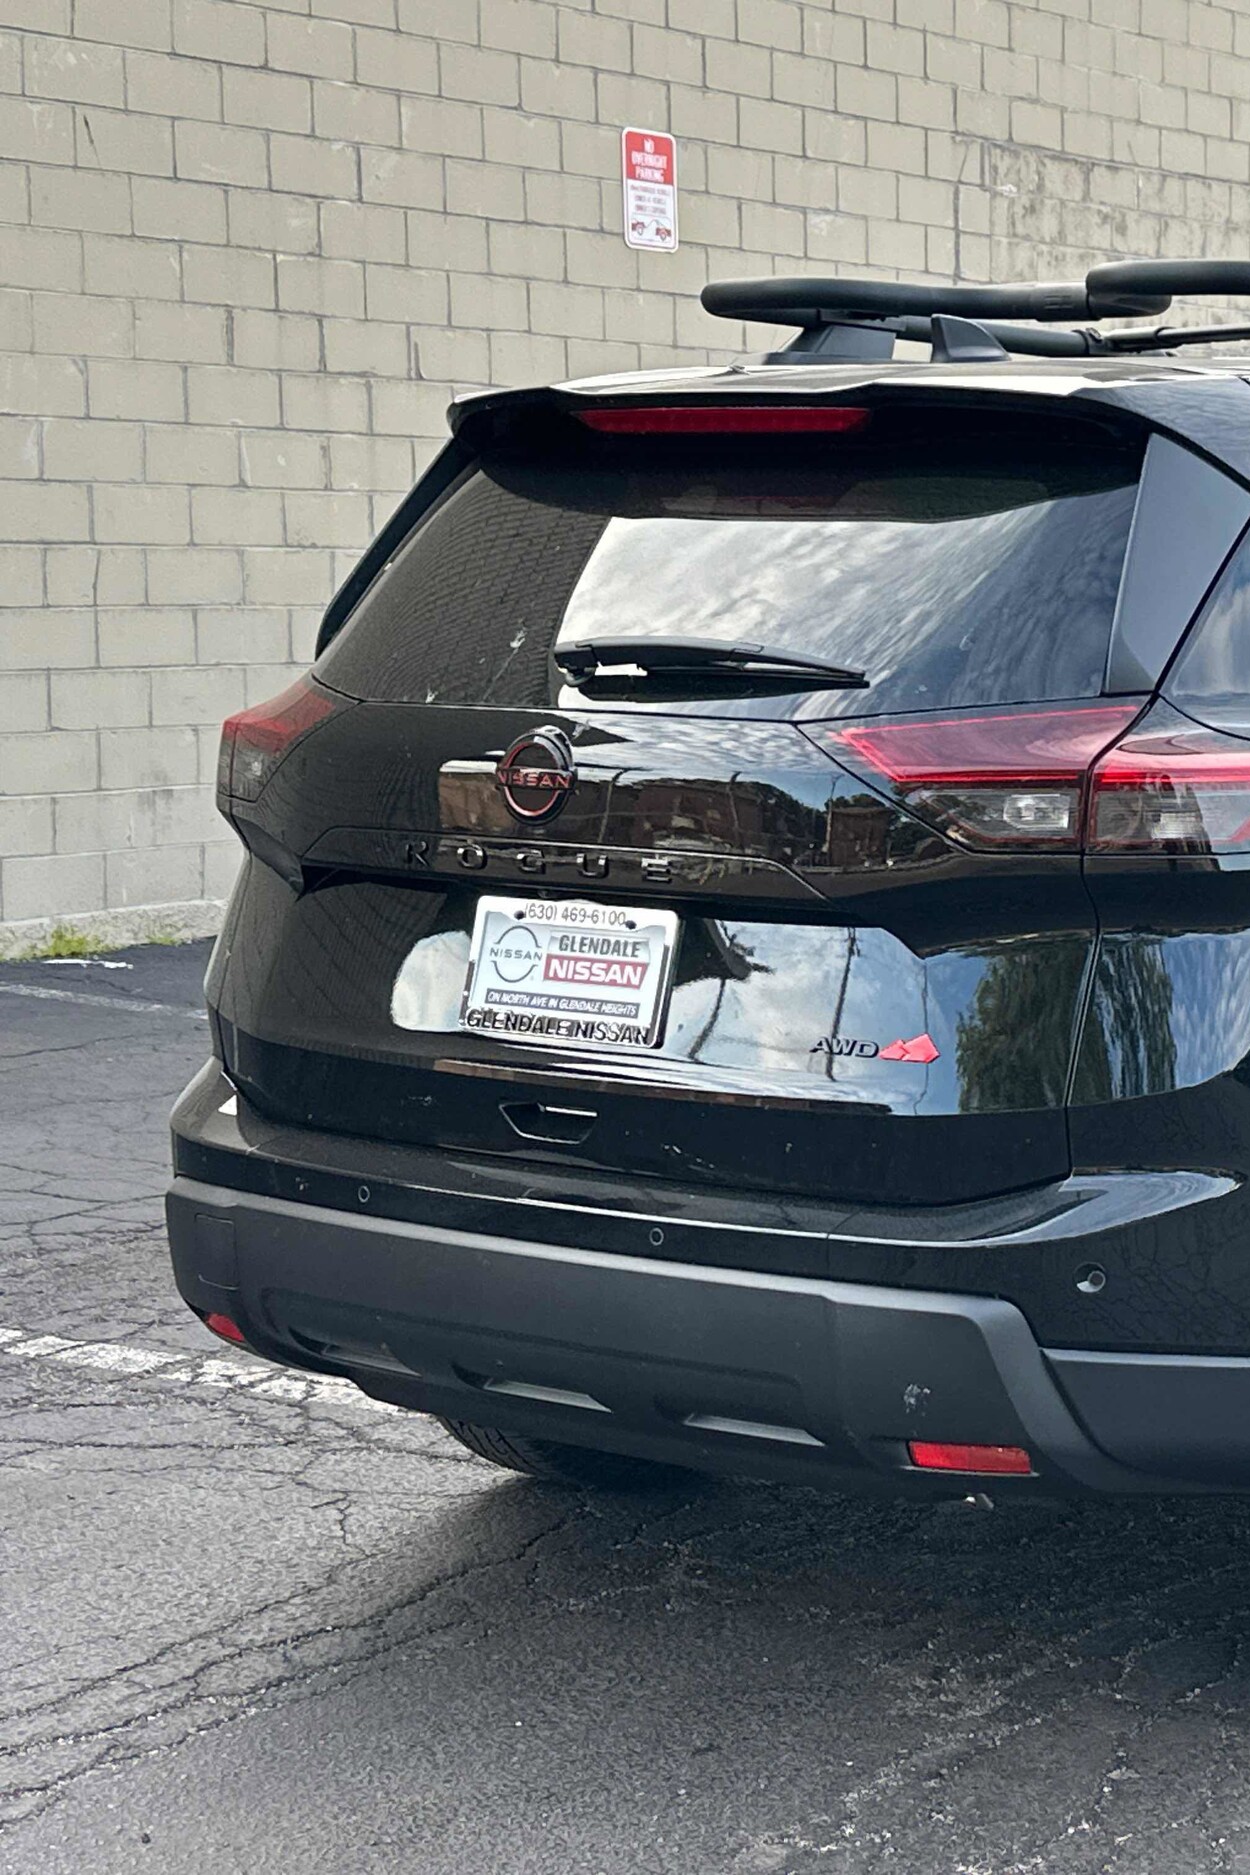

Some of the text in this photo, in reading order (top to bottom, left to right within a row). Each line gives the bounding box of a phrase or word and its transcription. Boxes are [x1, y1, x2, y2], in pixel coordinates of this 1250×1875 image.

[643, 138, 655, 153] NO
[631, 150, 668, 170] OVERNIGHT
[635, 165, 665, 183] PARKING
[497, 770, 572, 788] NISSAN
[405, 841, 673, 883] ROGUE
[523, 902, 627, 926] (630) 469-6100
[489, 946, 543, 961] NISSAN
[558, 934, 641, 958] GLENDALE
[548, 958, 644, 986] NISSAN
[487, 991, 638, 1017] ON NORTH AVE IN GLENDALE HEIGHTS
[466, 1008, 650, 1045] GLENDALE NISSAN
[809, 1036, 880, 1058] AWD
